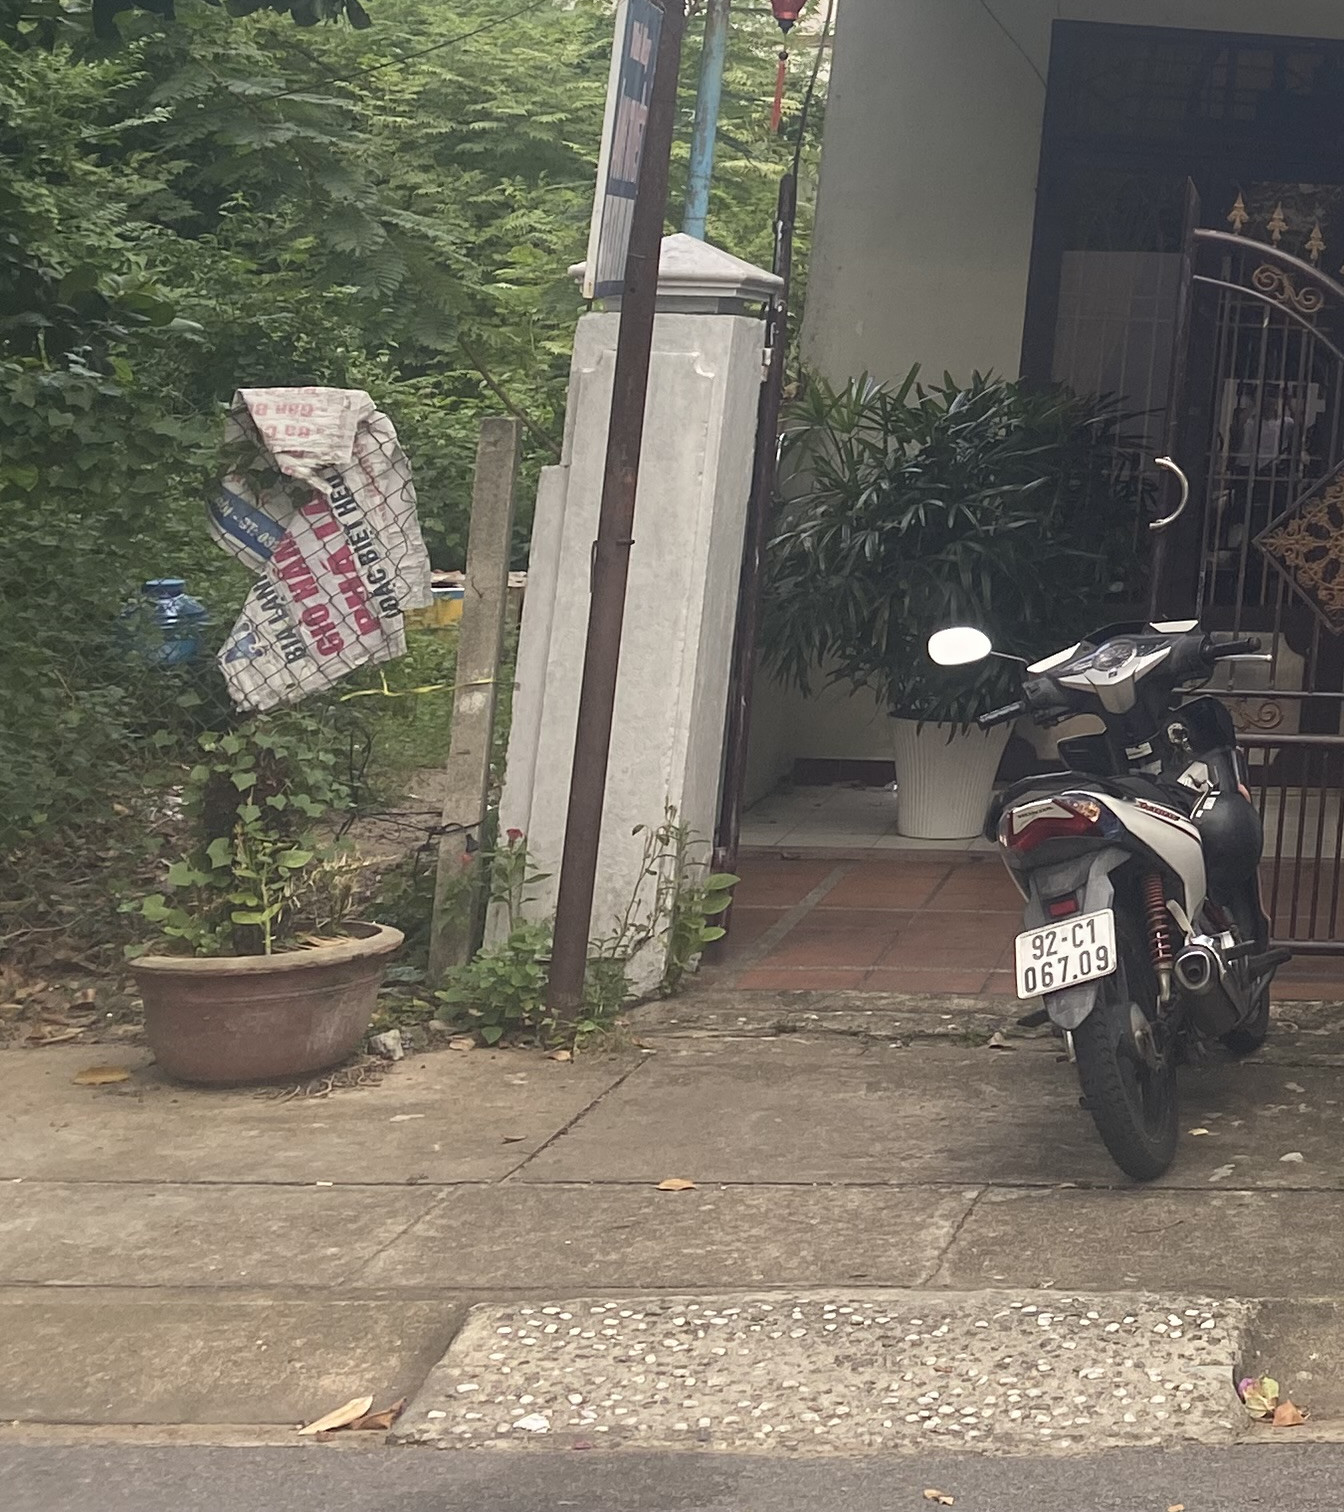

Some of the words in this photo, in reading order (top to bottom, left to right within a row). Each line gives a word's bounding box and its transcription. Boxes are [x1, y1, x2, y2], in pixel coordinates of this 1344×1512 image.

[320, 544, 381, 636] PHÁ
[275, 623, 306, 664] BIA
[1031, 919, 1097, 961] 92-C1
[1024, 945, 1109, 993] 067.09
